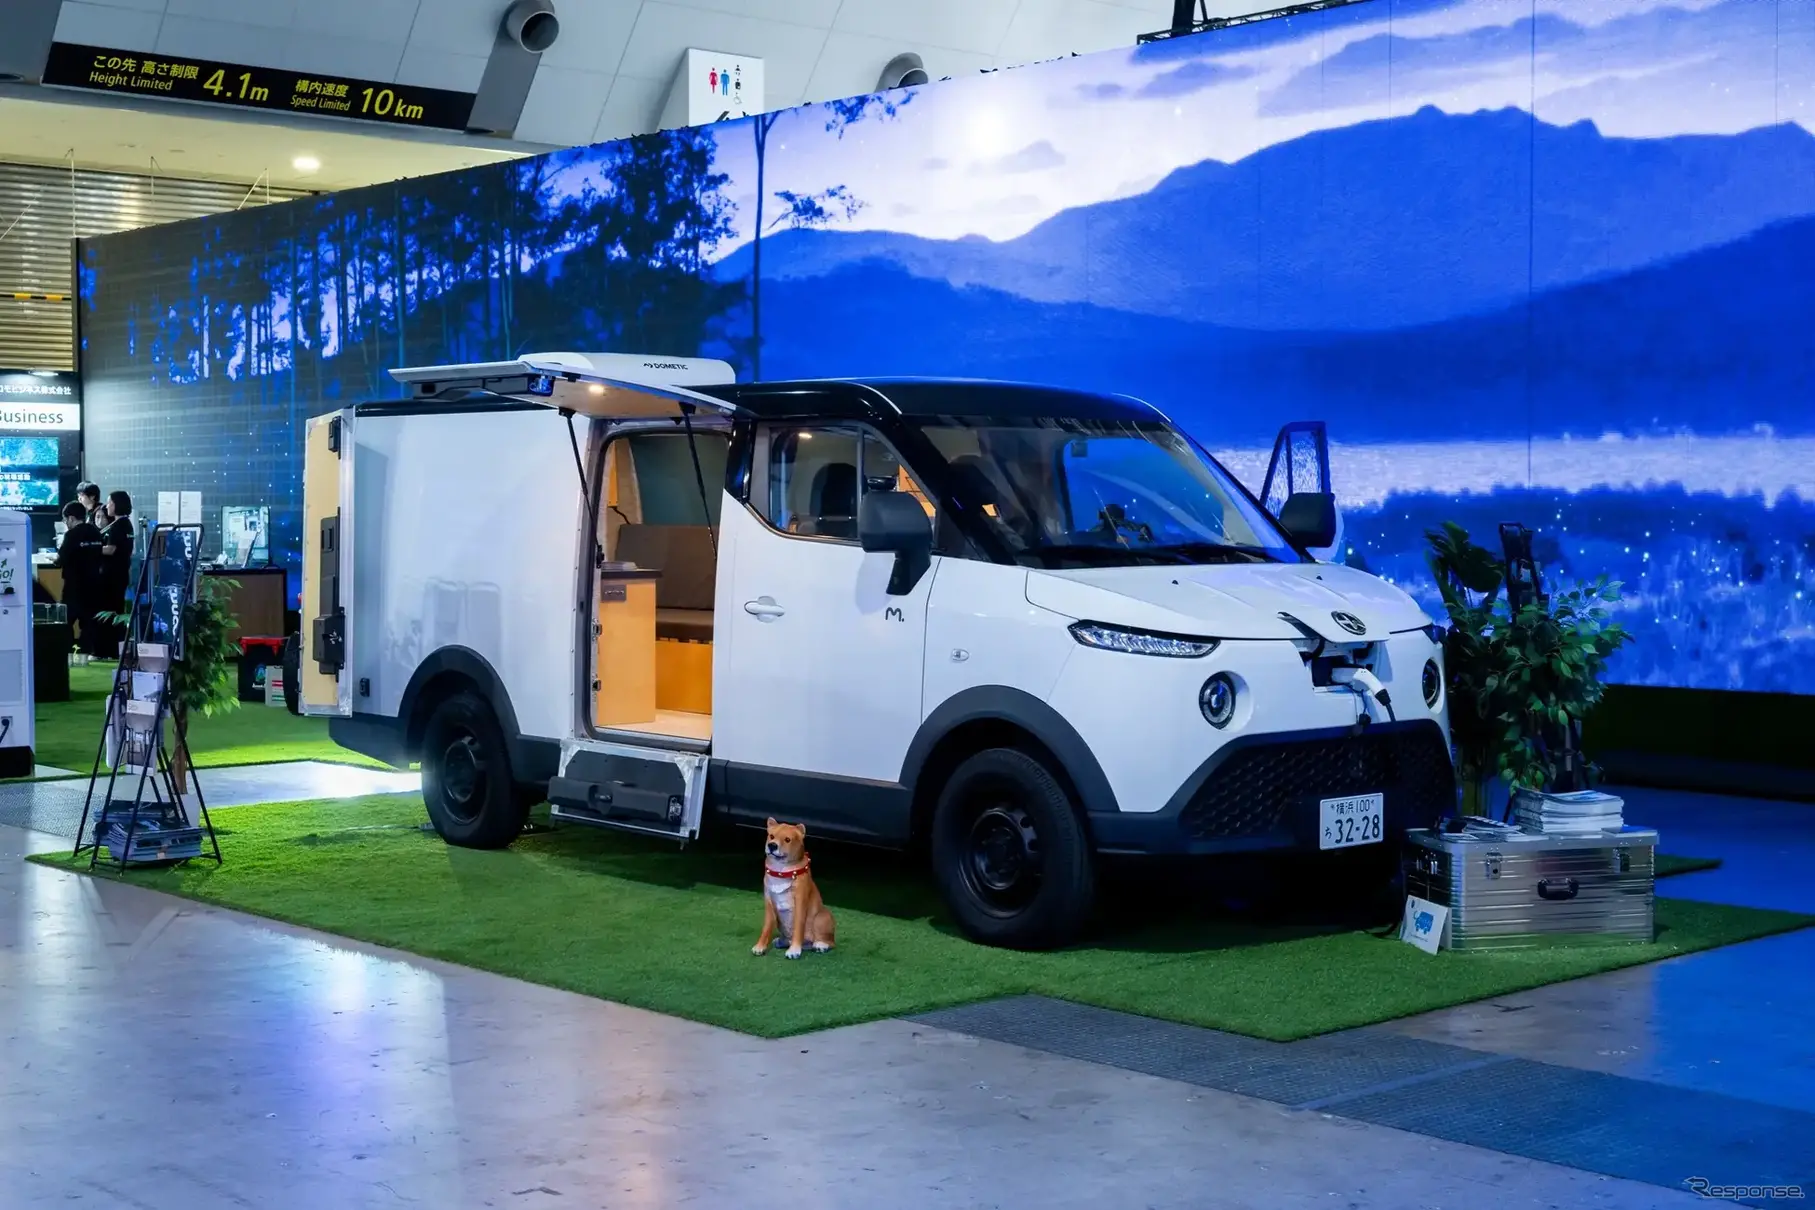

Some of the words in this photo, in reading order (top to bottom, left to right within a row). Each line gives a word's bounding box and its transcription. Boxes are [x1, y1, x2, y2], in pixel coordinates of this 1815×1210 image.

[94, 55, 137, 72] この先
[141, 60, 199, 80] 高さ制限
[89, 71, 127, 87] Height
[130, 75, 173, 91] Limited
[295, 79, 349, 98] 構内速度
[290, 94, 317, 108] Speed
[318, 98, 352, 111] Limited
[0, 409, 64, 424] usiness
[1334, 814, 1380, 844] 32-28
